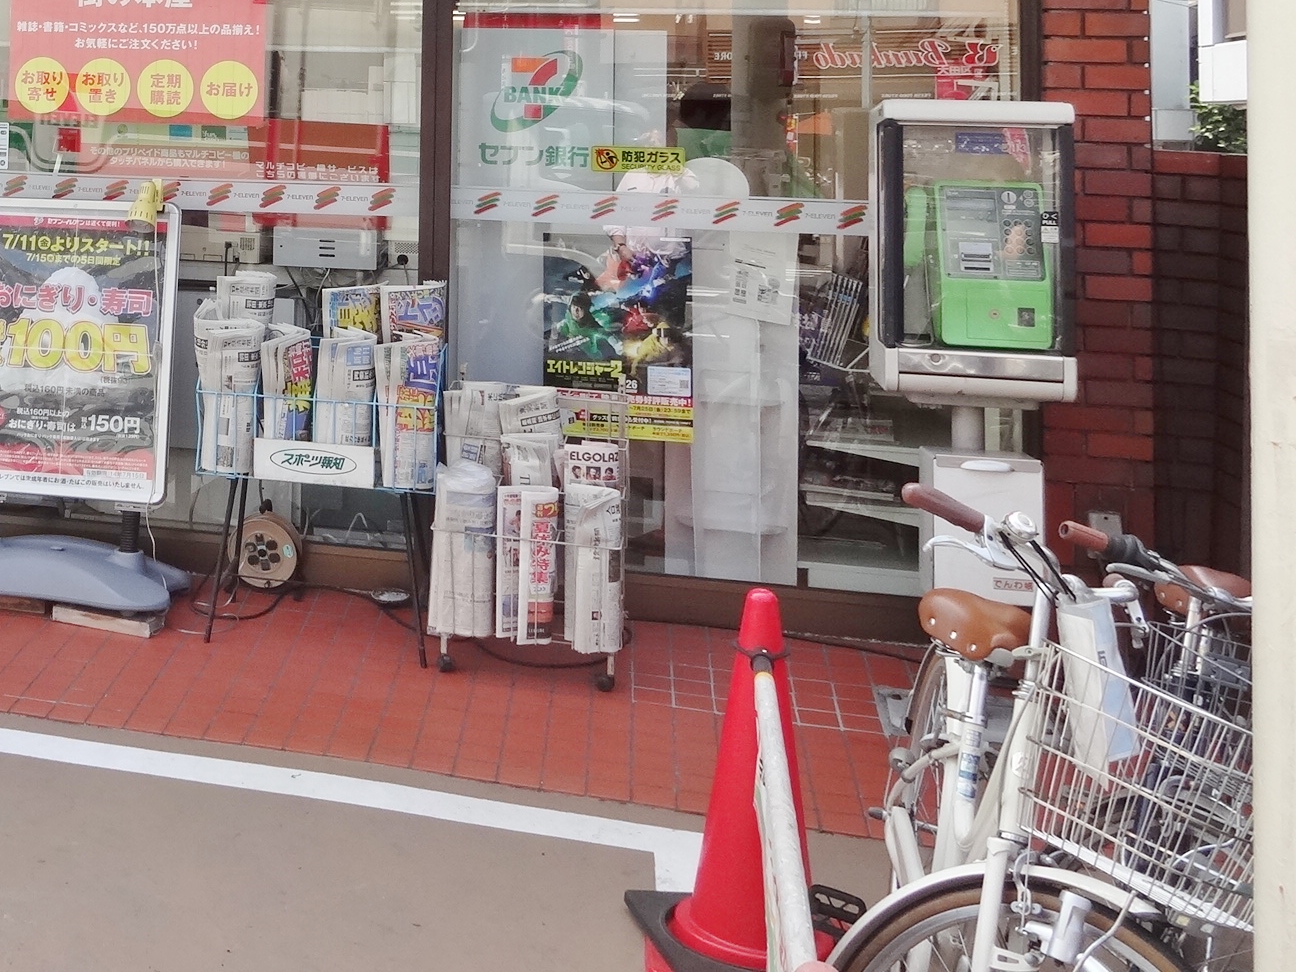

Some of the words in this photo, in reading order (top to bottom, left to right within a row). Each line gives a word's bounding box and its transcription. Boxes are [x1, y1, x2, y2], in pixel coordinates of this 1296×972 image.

[21, 71, 63, 86] お取り
[81, 72, 125, 86] お取り
[150, 73, 181, 88] 定期
[205, 81, 253, 97] お届け
[27, 87, 58, 102] 寄せ
[88, 88, 117, 104] 置き
[150, 90, 181, 105] 購読
[504, 86, 561, 104] BANK
[621, 150, 682, 164] 防犯ガラス
[7, 317, 152, 375] 100円
[547, 359, 622, 378] エイトレンジャー2
[89, 414, 141, 434] 150円
[280, 452, 346, 471] スポーツ報知
